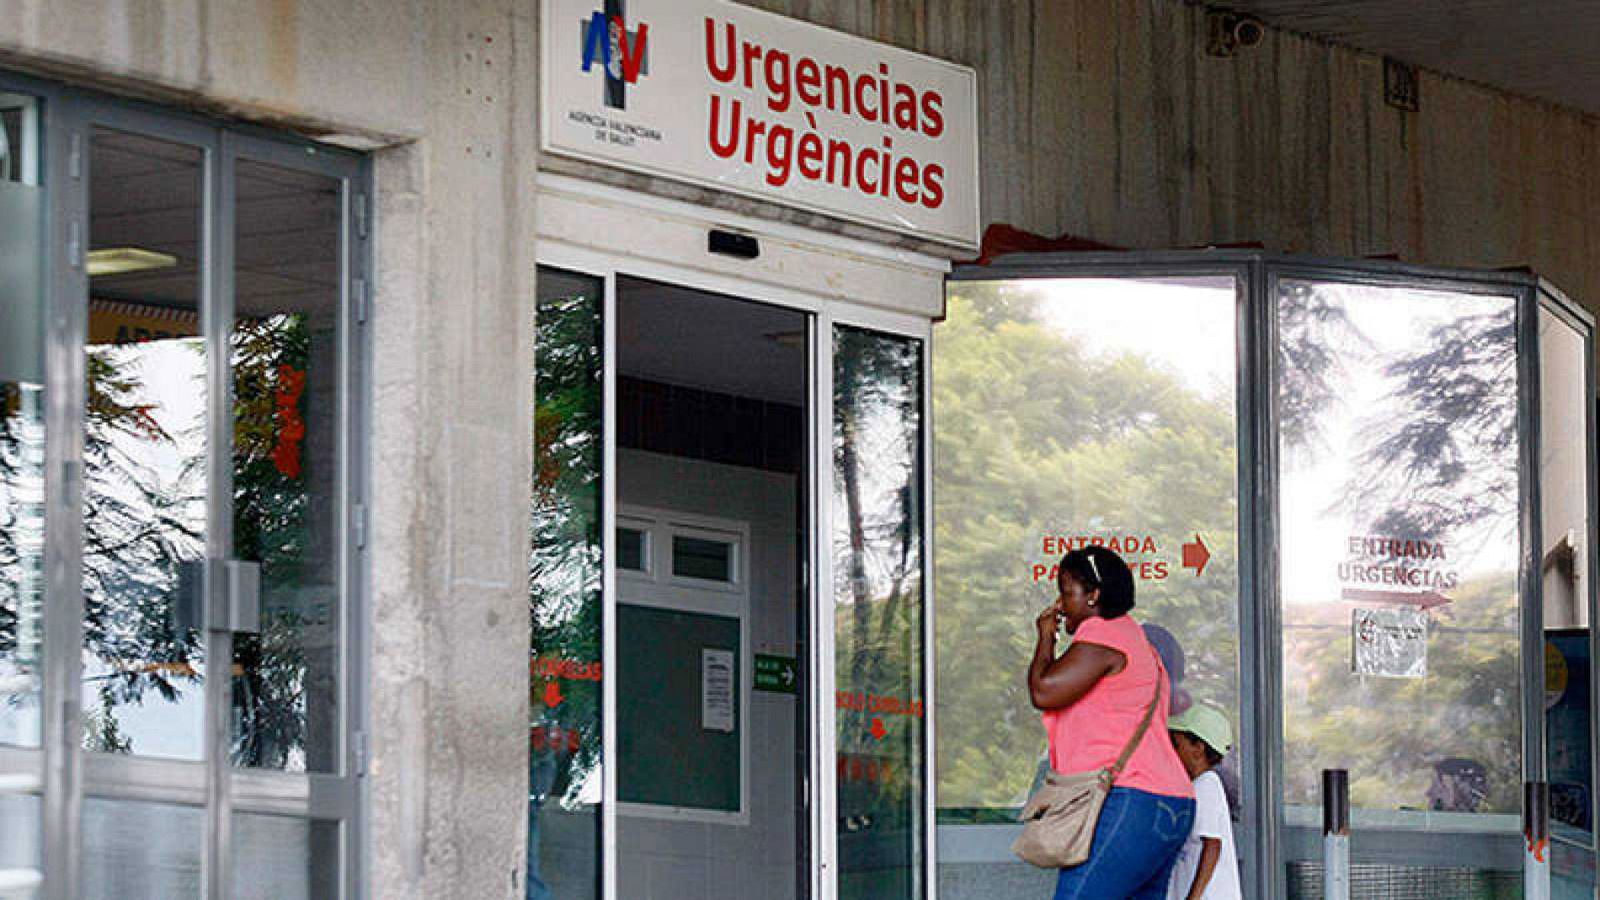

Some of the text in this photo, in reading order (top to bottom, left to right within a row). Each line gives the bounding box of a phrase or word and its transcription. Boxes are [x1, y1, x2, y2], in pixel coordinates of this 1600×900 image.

[705, 17, 944, 137] Urgencias
[709, 95, 945, 209] Urgències
[1337, 563, 1459, 588] URGENCIAS
[1348, 536, 1447, 560] ENTRADA
